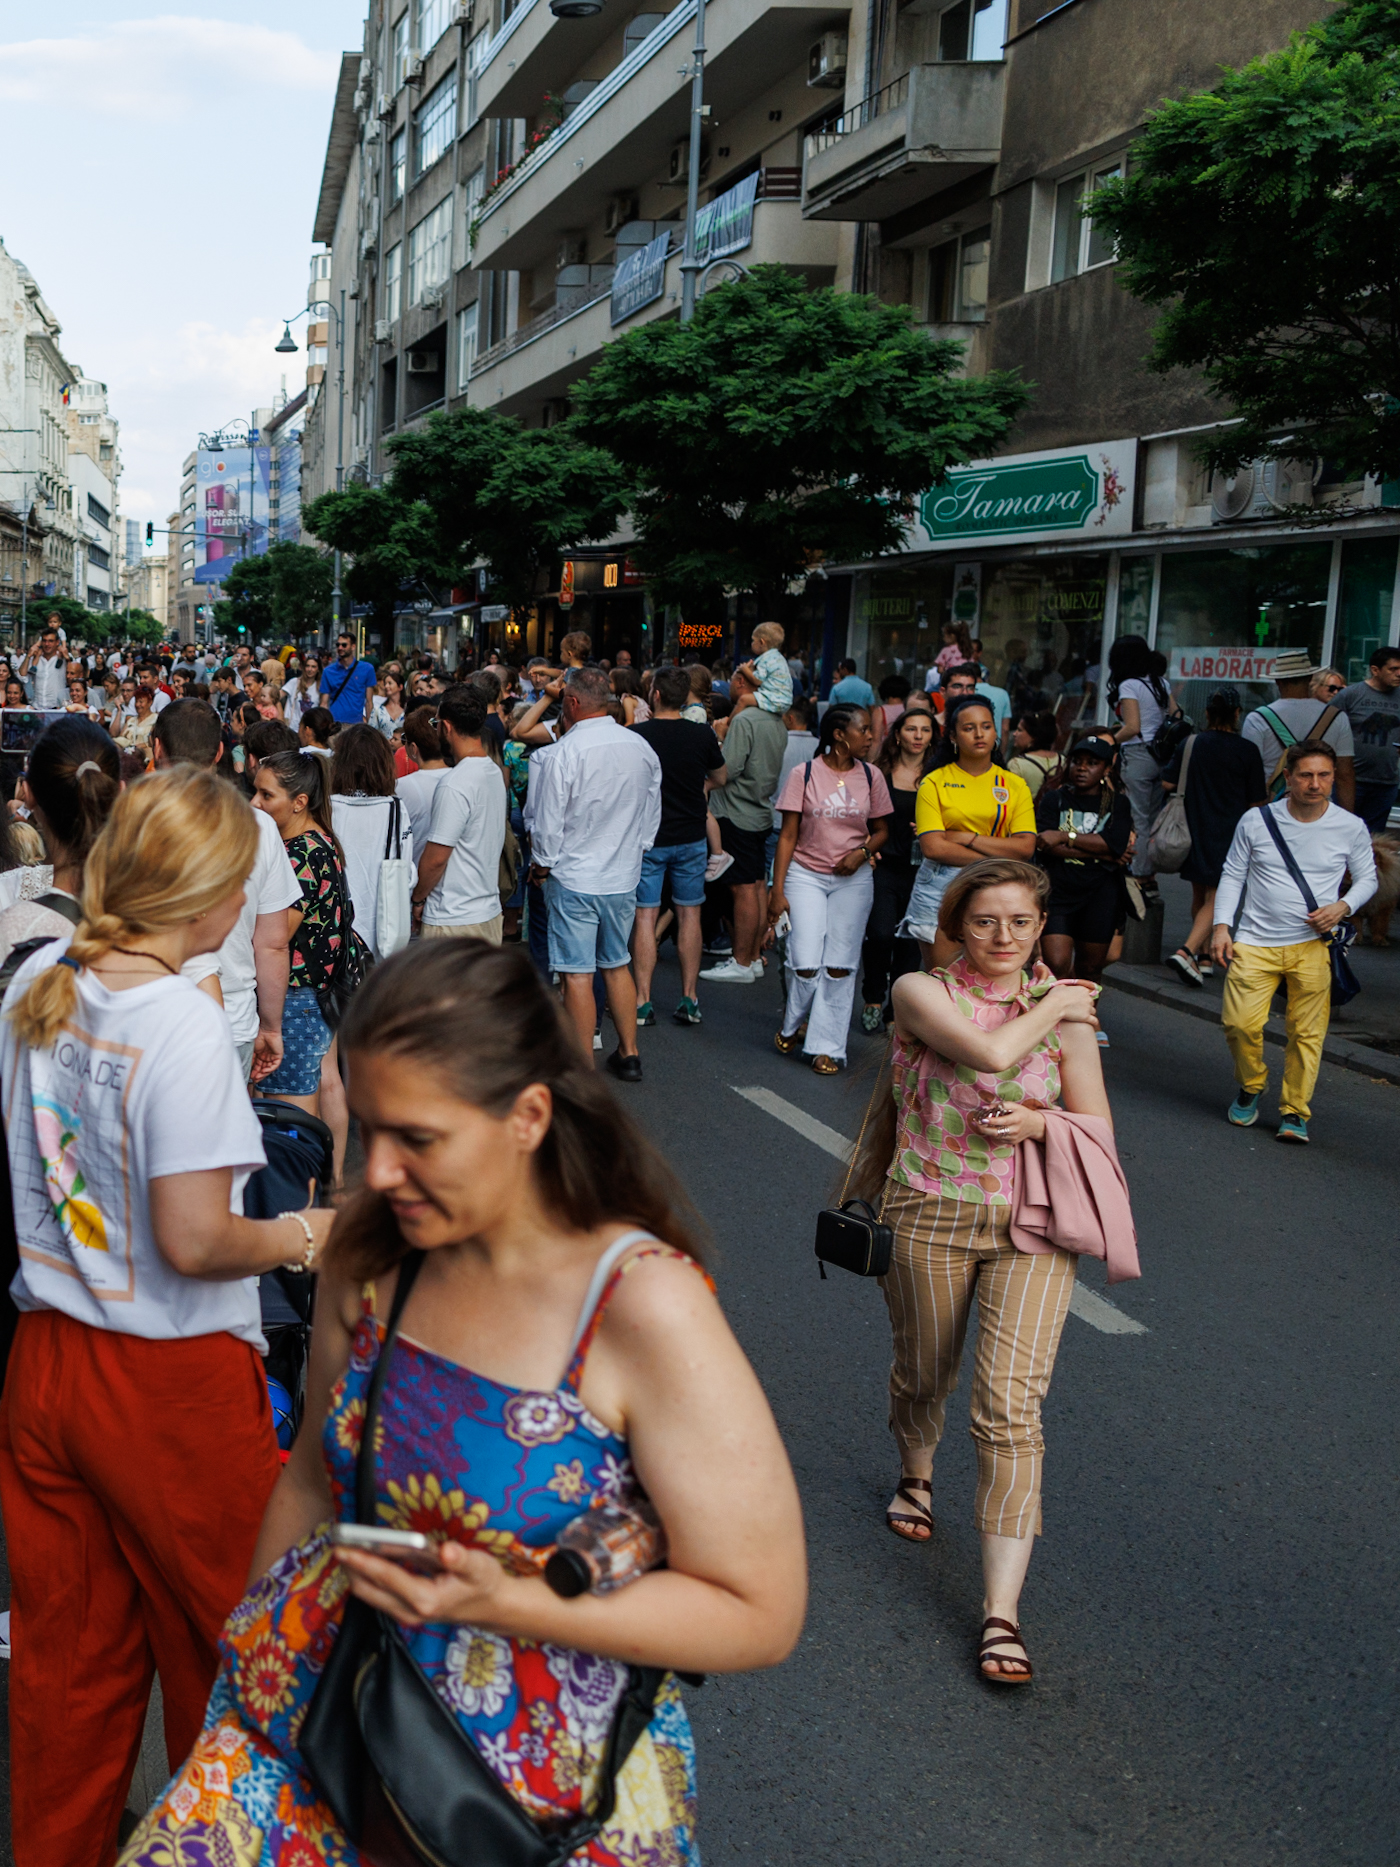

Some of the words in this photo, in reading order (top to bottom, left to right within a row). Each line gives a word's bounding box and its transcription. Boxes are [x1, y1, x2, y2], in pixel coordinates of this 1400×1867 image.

[200, 453, 227, 479] glo
[933, 475, 1083, 522] Tamara
[1048, 590, 1101, 611] COMENZI
[1218, 647, 1255, 658] FARMACIE
[812, 804, 866, 819] adidas
